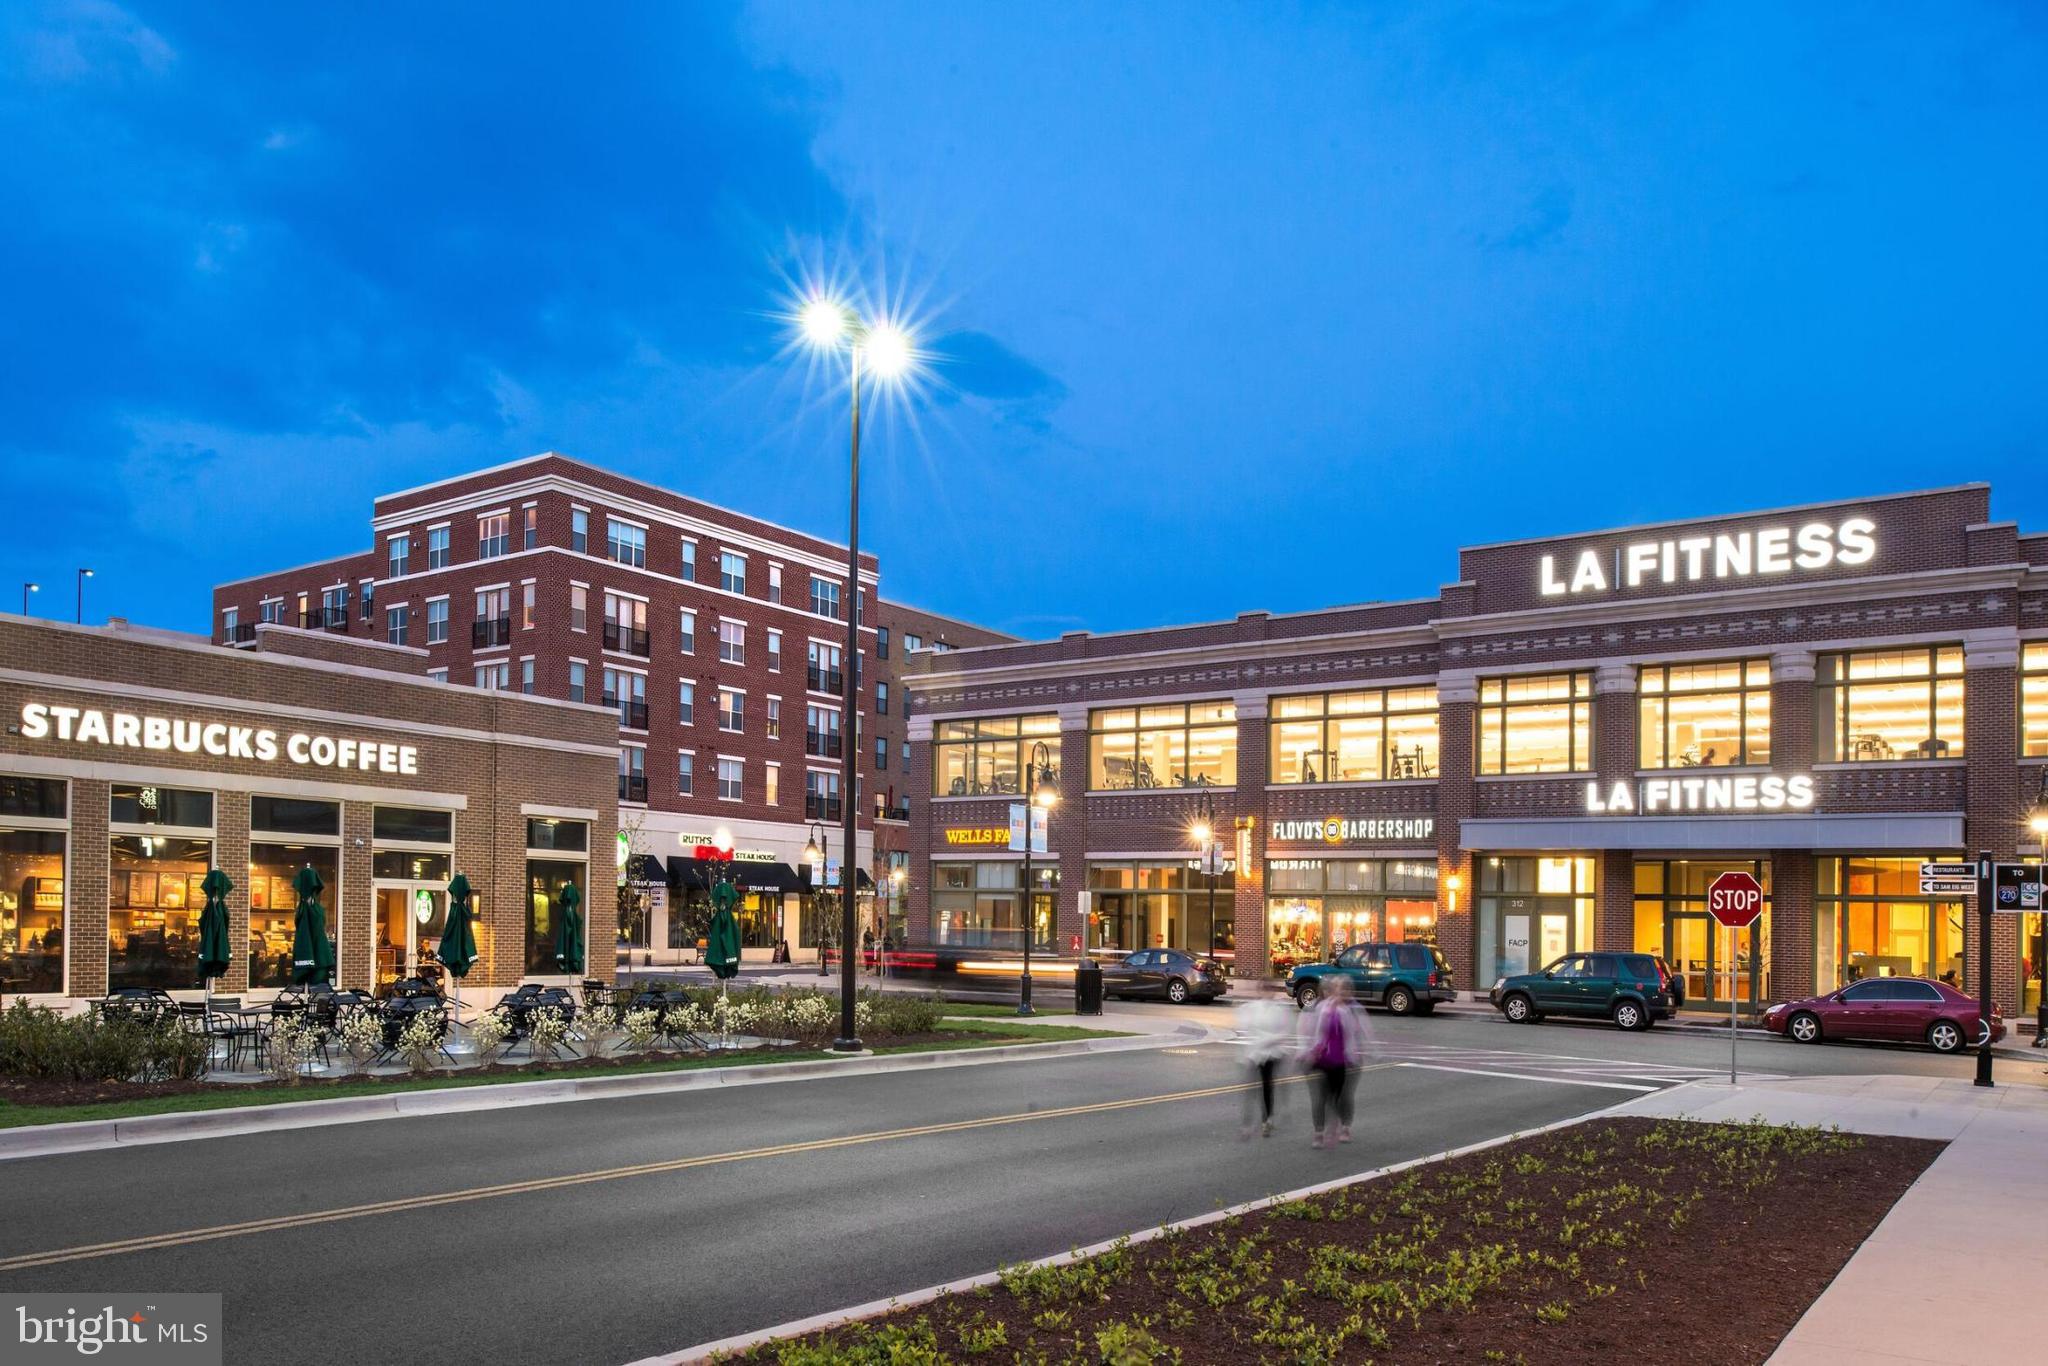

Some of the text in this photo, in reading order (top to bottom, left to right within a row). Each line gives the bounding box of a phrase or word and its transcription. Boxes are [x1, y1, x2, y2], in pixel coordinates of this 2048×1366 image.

[1540, 518, 1876, 596] LA FITNESS
[20, 703, 418, 774] STARBUCKS COFFEE
[1586, 775, 1814, 811] LA FITNESS
[1273, 821, 1324, 840] FLOYD'S
[1341, 819, 1433, 839] BARBERSHOP
[682, 834, 712, 845] RUTH'S
[945, 829, 992, 844] WELLS
[735, 852, 755, 860] STEAK
[756, 854, 776, 862] HOUSE
[2012, 869, 2024, 877] TO
[2022, 882, 2039, 892] ICC
[1712, 889, 1759, 911] STOP
[2001, 890, 2016, 900] 270
[1508, 939, 1529, 947] FACP
